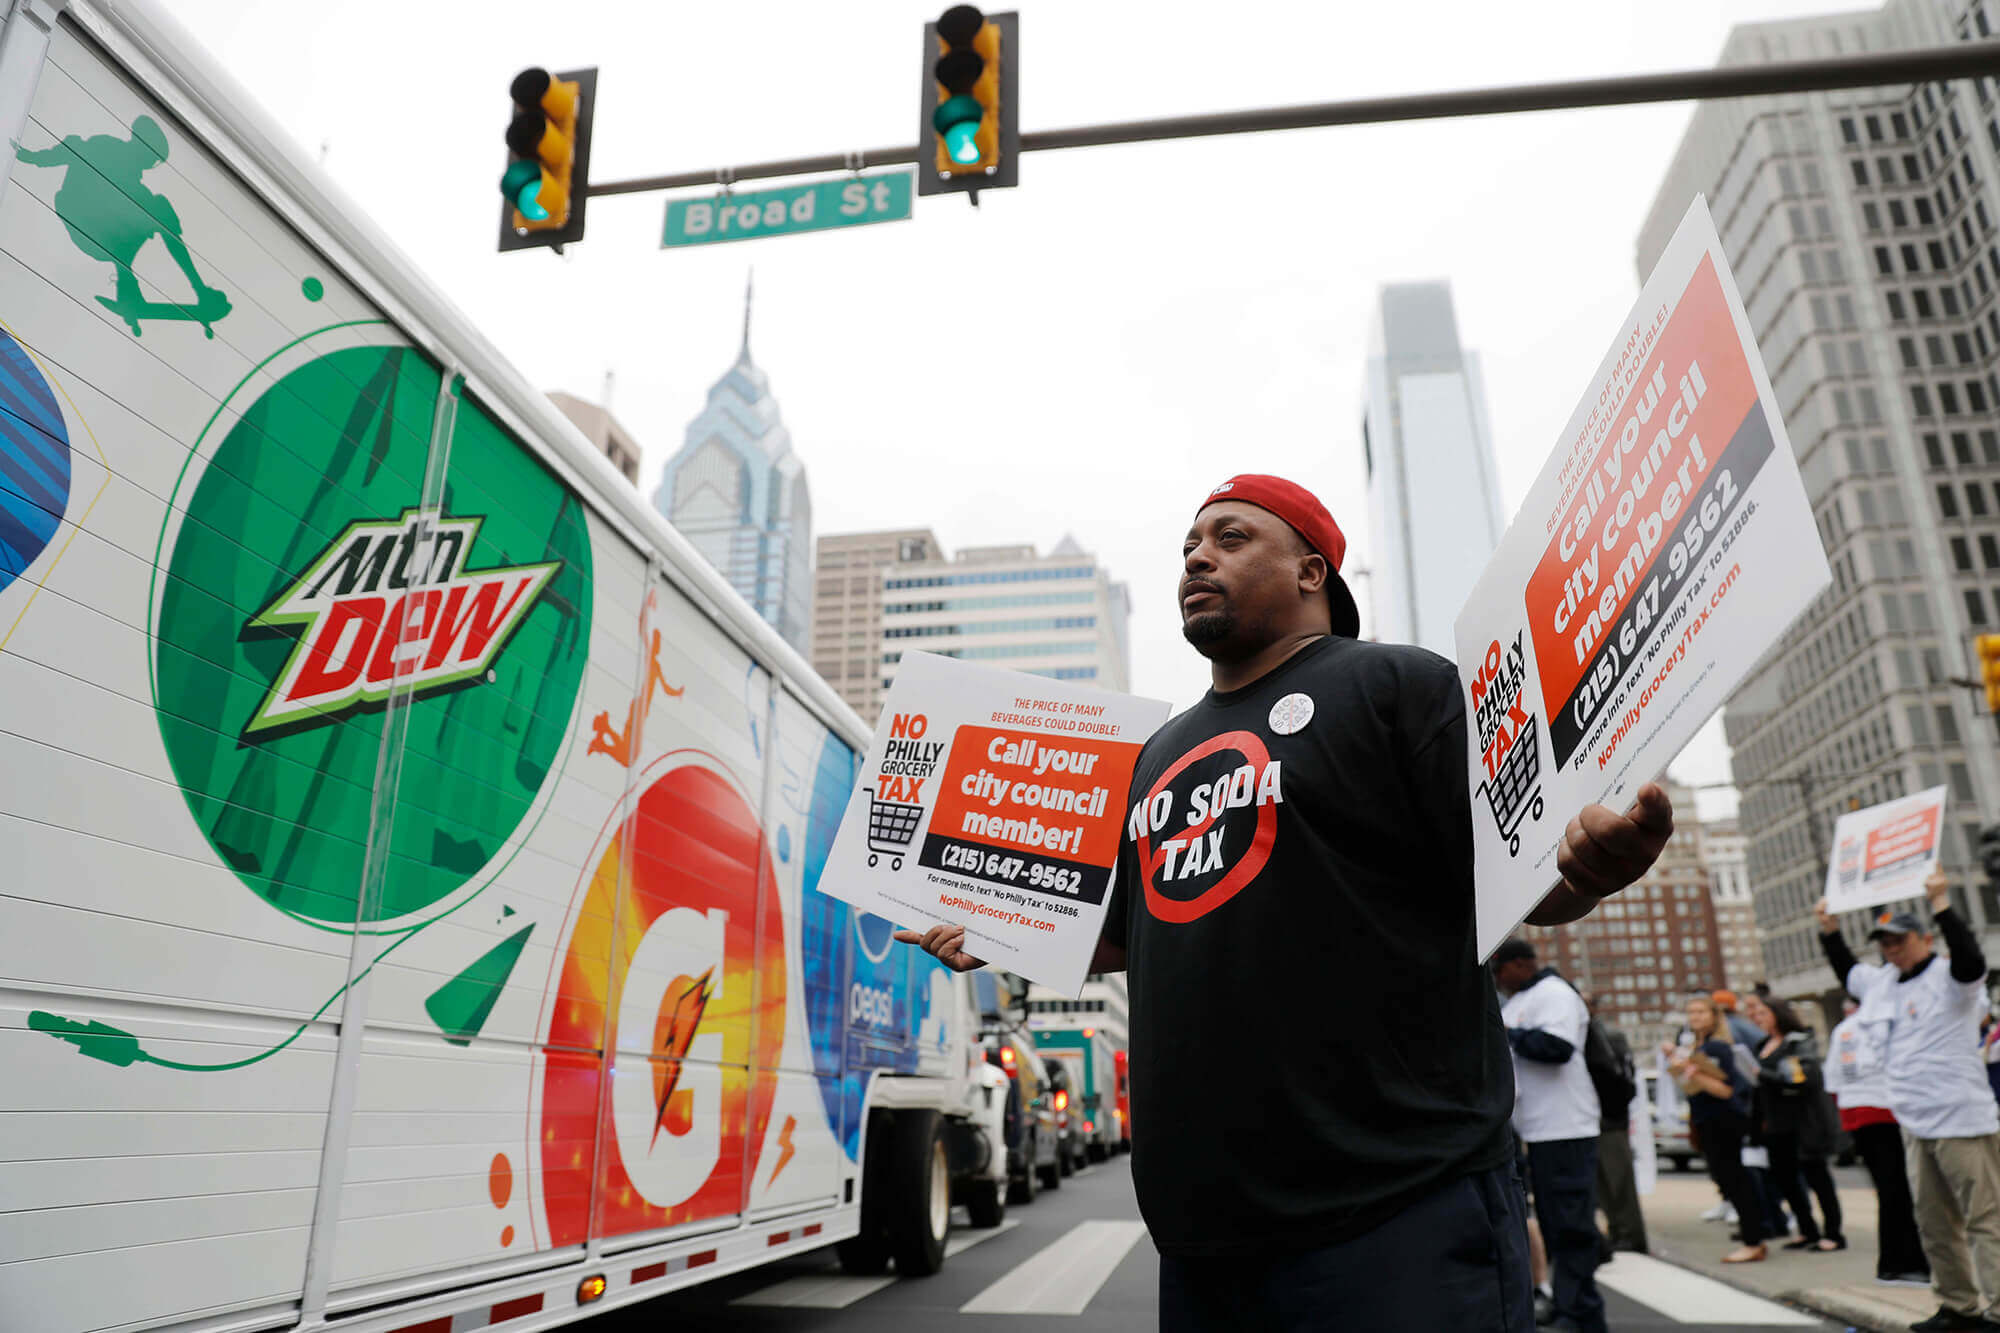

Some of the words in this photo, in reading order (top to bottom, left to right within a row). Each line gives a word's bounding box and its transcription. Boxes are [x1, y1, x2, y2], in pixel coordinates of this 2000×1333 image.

[684, 190, 816, 235] Broad
[840, 181, 890, 216] St
[1546, 443, 1592, 533] BEVERAGES
[1594, 385, 1624, 444] COULD
[1625, 303, 1668, 385] DOUBLE!
[1558, 454, 1574, 485] THE
[1574, 406, 1599, 456] PRICE
[1600, 379, 1611, 406] OF
[1613, 322, 1640, 381] MANY
[1559, 469, 1606, 562] Call
[1603, 360, 1667, 493] your
[1554, 542, 1598, 633] city
[1602, 360, 1707, 551] council
[1574, 433, 1707, 666] member!
[1574, 645, 1619, 730] (215)
[1620, 469, 1738, 656] 647-9562
[1471, 639, 1501, 713] NO
[1476, 628, 1523, 738] PHILLY
[1574, 748, 1588, 770] For
[1588, 717, 1608, 752] more
[1626, 662, 1645, 692] text
[1661, 601, 1687, 643] Philly
[1710, 551, 1722, 570] to
[1598, 563, 1741, 771] NoPhillyGroceryTax.com
[889, 713, 928, 739] NO
[991, 712, 1042, 727] BEVERAGES
[1044, 718, 1076, 731] COULD
[1078, 721, 1120, 736] DOUBLE!
[1014, 698, 1030, 710] THE
[1032, 700, 1058, 712] PRICE
[1060, 703, 1073, 714] OF
[1074, 704, 1105, 717] MANY
[1480, 657, 1525, 754] GROCERY
[885, 740, 944, 763] PHILLY
[987, 736, 1037, 767] Call
[1032, 747, 1099, 776] your
[1482, 688, 1528, 782] TAX
[877, 774, 925, 804] TAX
[881, 760, 936, 777] GROCERY
[961, 769, 1011, 806] city
[1010, 782, 1109, 818] council
[1128, 790, 1173, 842] NO
[1186, 760, 1284, 826] SODA
[961, 811, 1084, 854] member!
[1161, 824, 1226, 882] TAX
[927, 873, 939, 883] For
[940, 878, 959, 889] more
[976, 886, 991, 895] text
[1005, 892, 1026, 906] Philly
[1045, 902, 1053, 911] to
[940, 893, 1055, 932] NoPhillyGroceryTax.com
[850, 983, 894, 1030] pepsi
